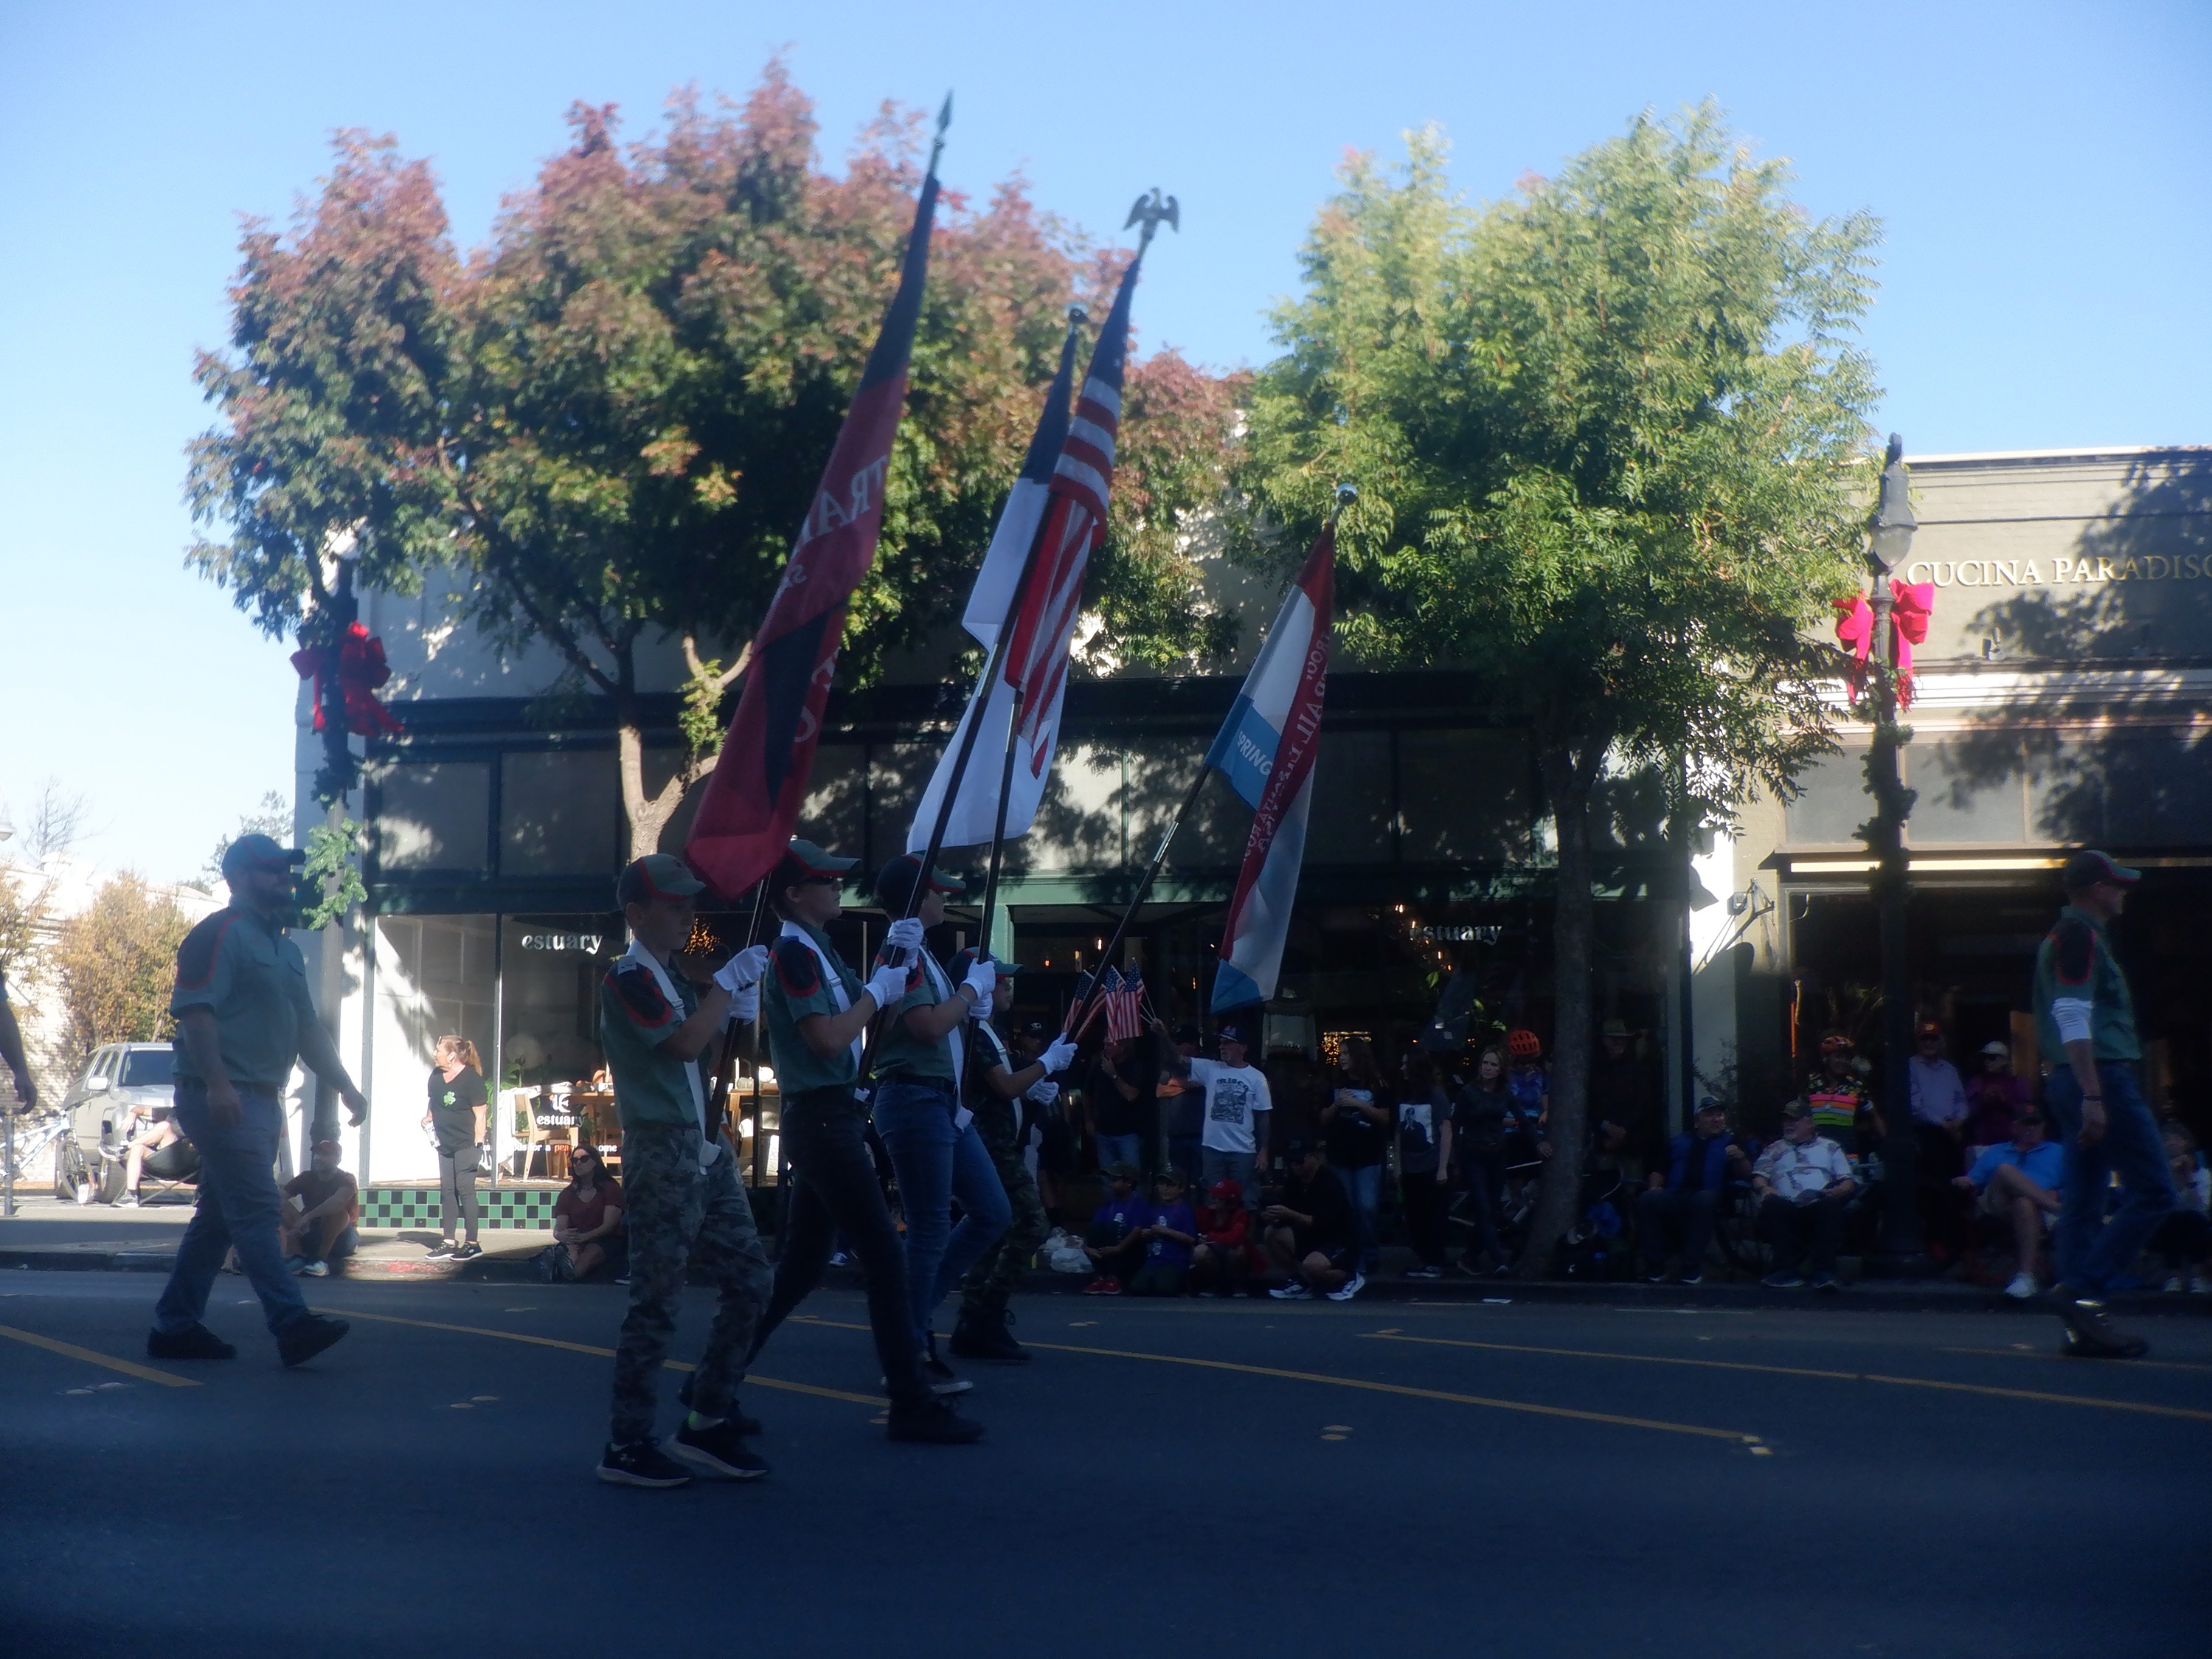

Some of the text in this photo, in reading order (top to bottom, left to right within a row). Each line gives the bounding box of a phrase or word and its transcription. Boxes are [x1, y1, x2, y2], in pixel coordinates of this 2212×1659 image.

[1907, 558, 2043, 588] CUCINA
[521, 933, 603, 955] estuary
[1409, 925, 1503, 946] estuary
[536, 1115, 587, 1128] estuary
